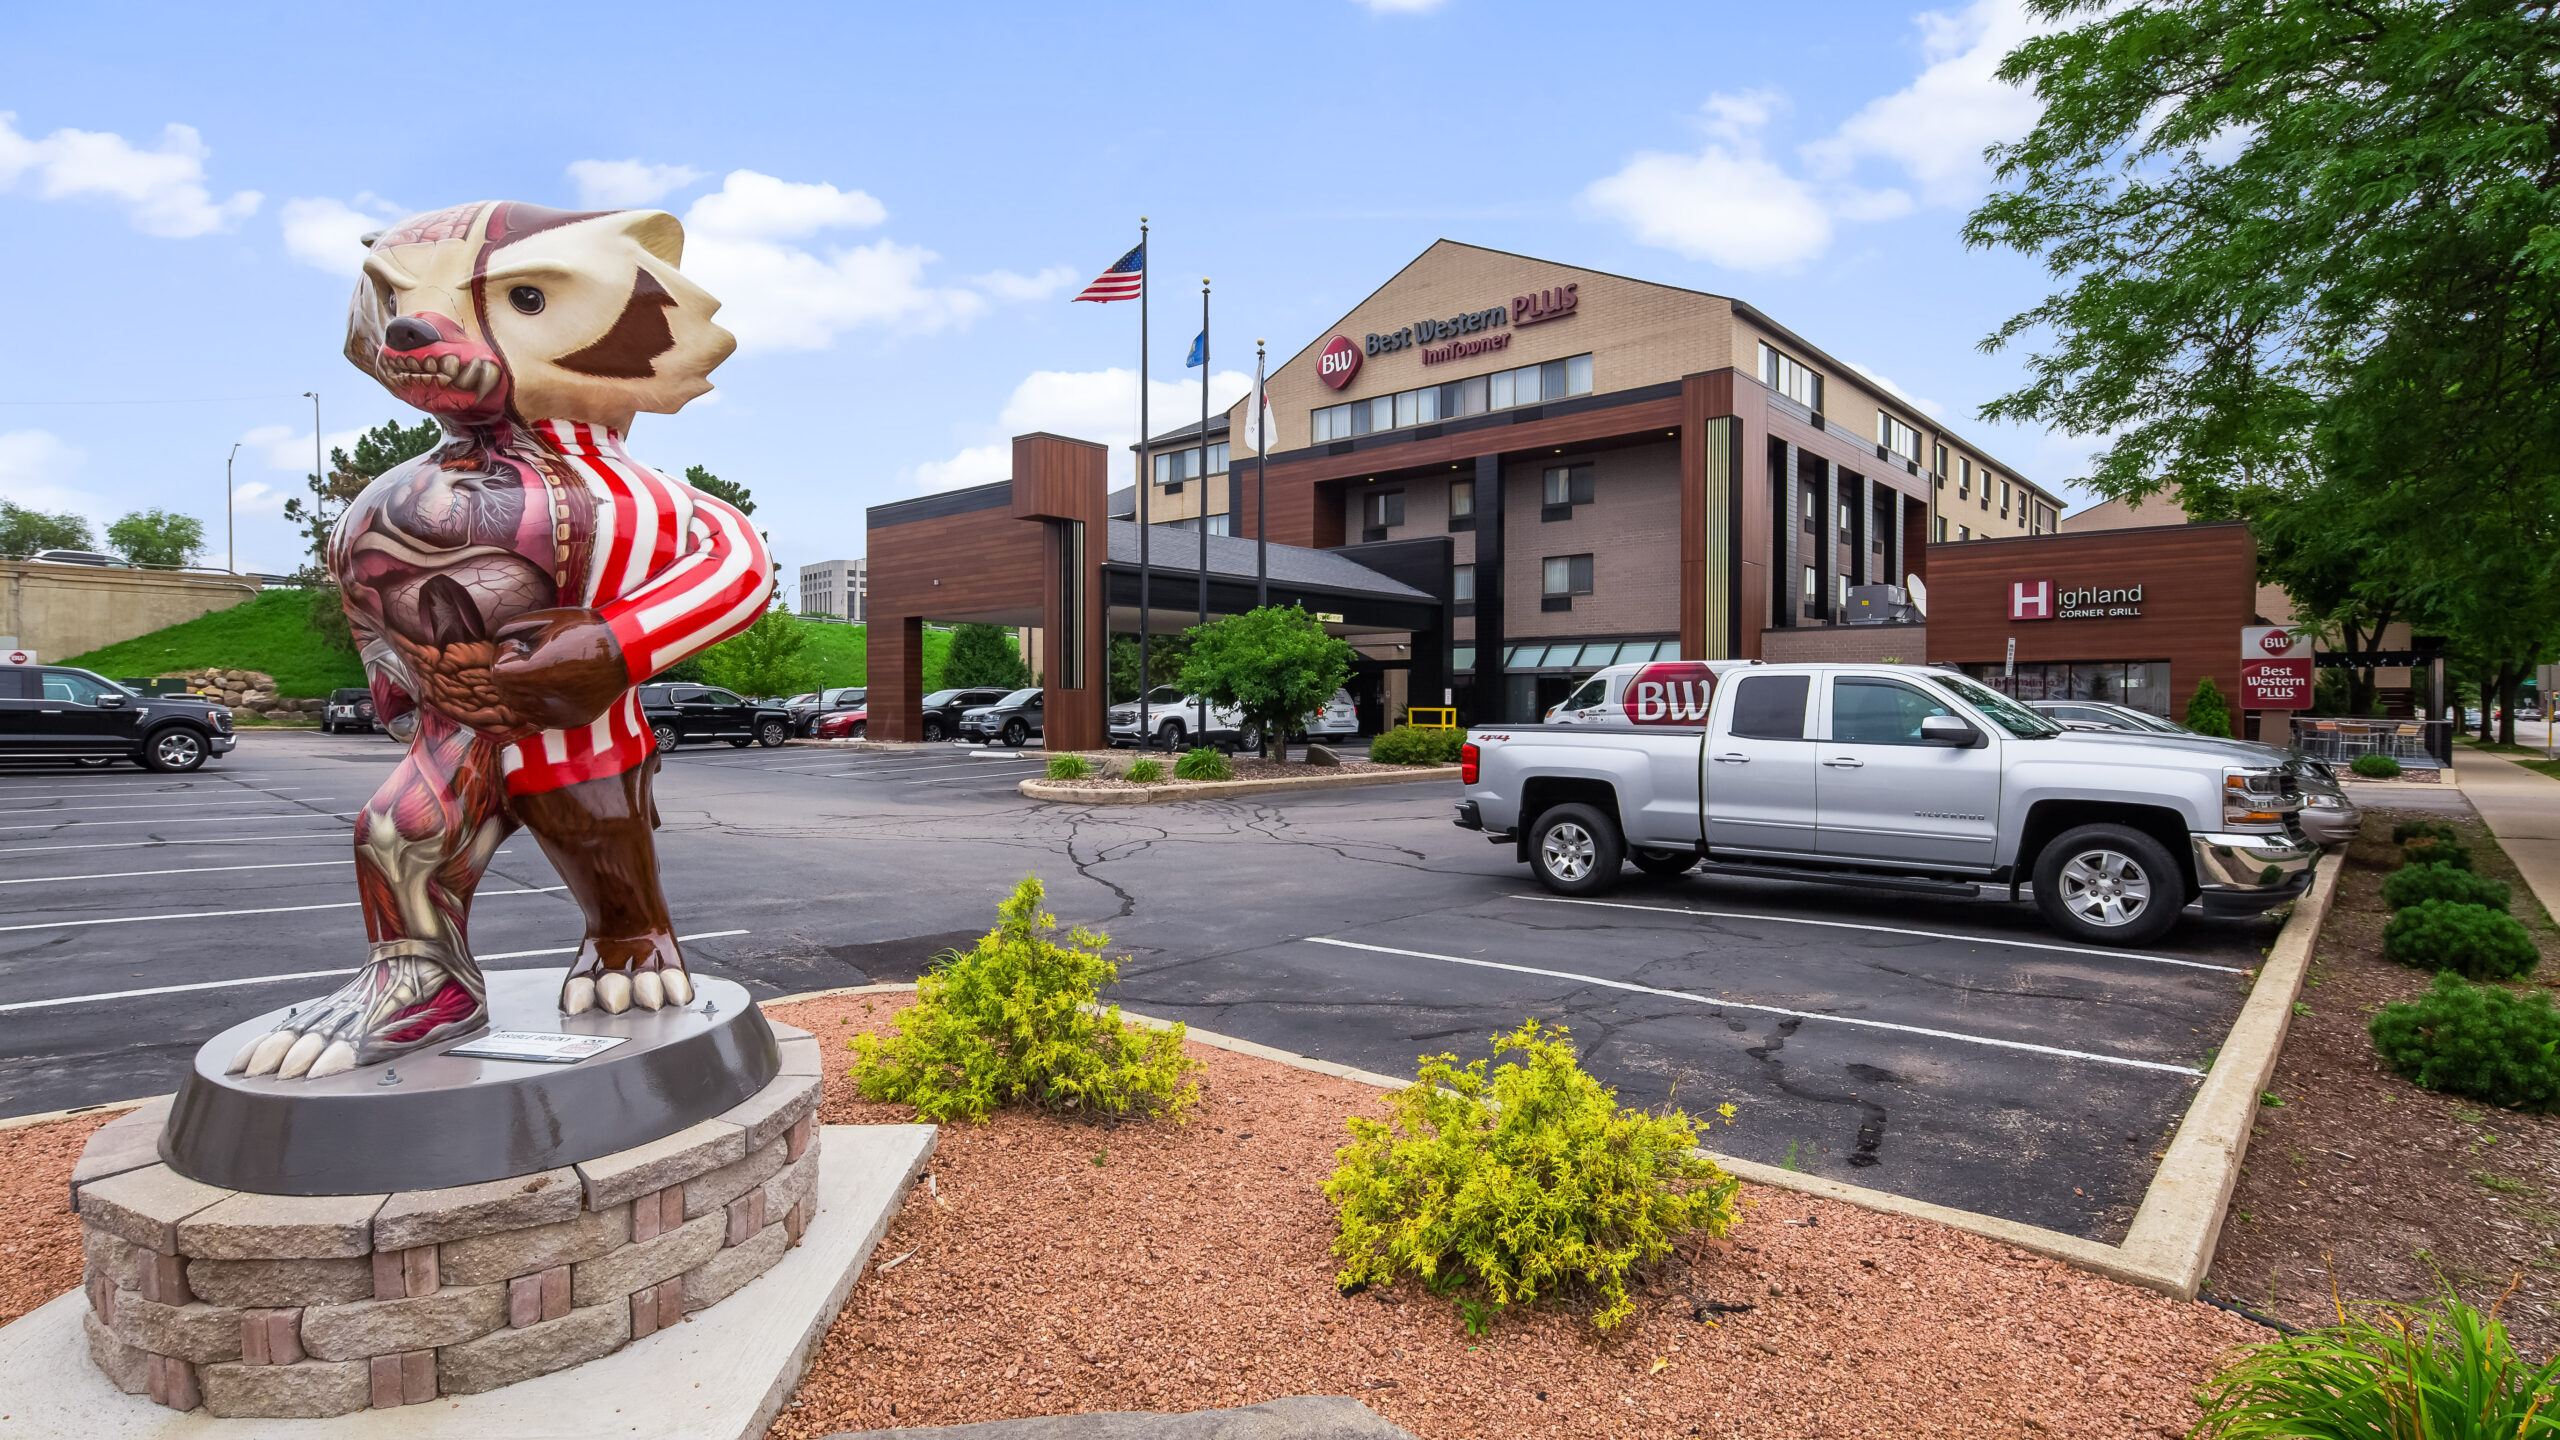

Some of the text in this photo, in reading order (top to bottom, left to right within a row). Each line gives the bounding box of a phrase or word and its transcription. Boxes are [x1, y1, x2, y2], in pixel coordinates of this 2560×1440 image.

[1366, 283, 1578, 357] Best Western PLUS
[1422, 333, 1511, 365] InnTowner
[1322, 349, 1352, 375] BW
[2059, 607, 2141, 618] CORNER GRILL
[2264, 637, 2289, 648] BW
[2261, 666, 2292, 676] Best
[2247, 676, 2305, 686] Western
[2257, 687, 2295, 697] PLUS
[1637, 680, 1710, 721] BW
[1914, 810, 1985, 821] SILVERADO
